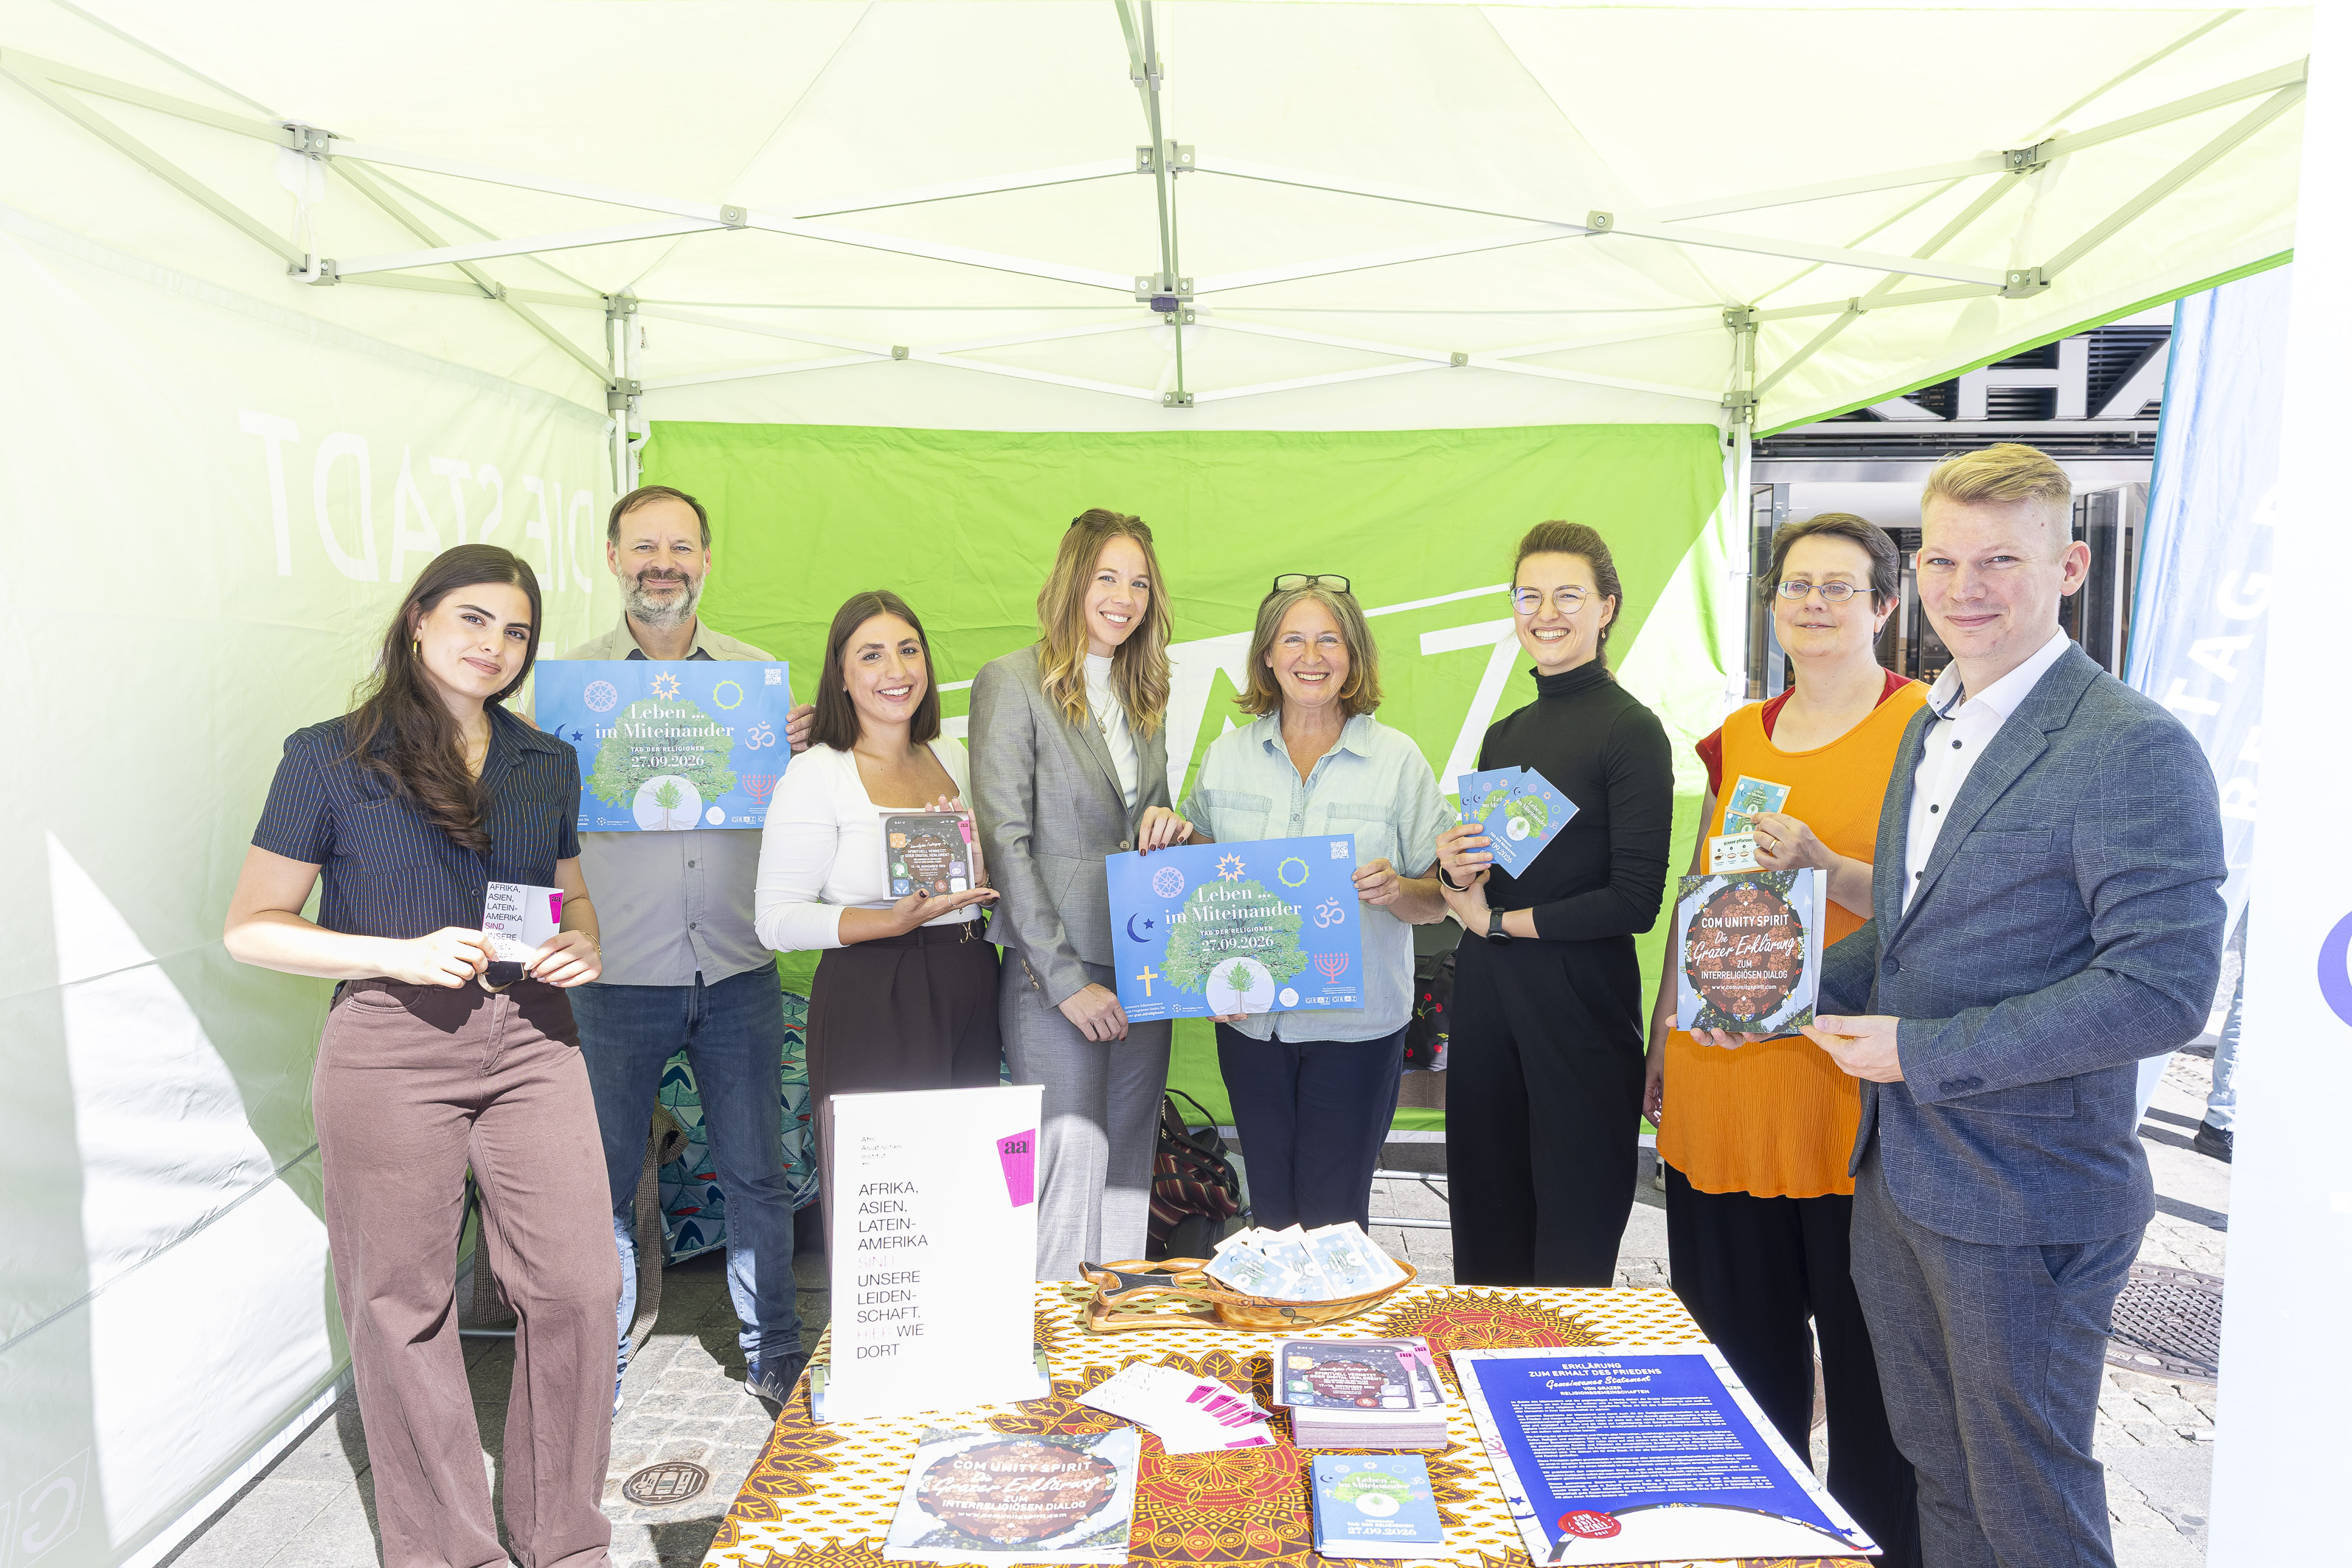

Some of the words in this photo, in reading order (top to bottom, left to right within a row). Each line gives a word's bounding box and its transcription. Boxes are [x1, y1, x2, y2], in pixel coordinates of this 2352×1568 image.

[2162, 569, 2272, 716] TAG
[631, 704, 686, 720] Leben
[595, 724, 617, 739] im
[622, 722, 735, 739] Miteinander
[631, 755, 704, 769] 27.09.2026
[1516, 798, 1523, 806] im
[1528, 800, 1543, 816] Leben
[489, 884, 521, 893] AFRIKA,
[1198, 886, 1252, 903] Leben
[488, 893, 514, 902] ASIEN,
[487, 903, 518, 912] LATEIN-
[1165, 909, 1187, 925] im
[1192, 901, 1302, 923] Miteinander
[485, 912, 523, 922] AMERIKA
[1701, 916, 1725, 928] COM
[1726, 915, 1755, 927] UNITY
[1757, 914, 1789, 926] SPIRIT
[485, 922, 504, 930] SIND
[1231, 926, 1273, 934] RELIGIONEN
[1201, 936, 1274, 952] 27.09.2026
[1715, 931, 1728, 944] Die
[1693, 941, 1734, 966] Grazer
[1735, 934, 1795, 957] Erklärung
[1737, 960, 1752, 968] ZUM
[1701, 968, 1762, 979] INTERRELIGIÖSEN
[1763, 970, 1788, 979] DIALOG
[858, 1182, 919, 1196] AFRIKA,
[858, 1200, 908, 1215] ASIEN,
[858, 1218, 917, 1233] LATEIN-
[858, 1235, 929, 1251] AMERIKA
[857, 1255, 895, 1269] SIND
[857, 1271, 921, 1287] UNSERE
[857, 1289, 917, 1305] LEIDEN-
[856, 1306, 920, 1323] SCHAFT.
[896, 1323, 925, 1337] WIE
[856, 1343, 901, 1359] DORT
[1546, 1379, 1603, 1390] Gemeinsames
[1605, 1376, 1651, 1384] Statement
[953, 1460, 987, 1471] COM
[991, 1461, 1041, 1473] UNITY
[1041, 1461, 1092, 1473] SPIRIT
[974, 1472, 993, 1482] Die
[932, 1479, 1002, 1496] Grazer
[1002, 1476, 1101, 1494] Erklärung
[1352, 1482, 1410, 1490] Miteinander
[942, 1499, 1047, 1510] INTERRELIGIÖSEN
[1046, 1500, 1086, 1510] DIALOG
[1347, 1527, 1417, 1536] 27.09.2026
